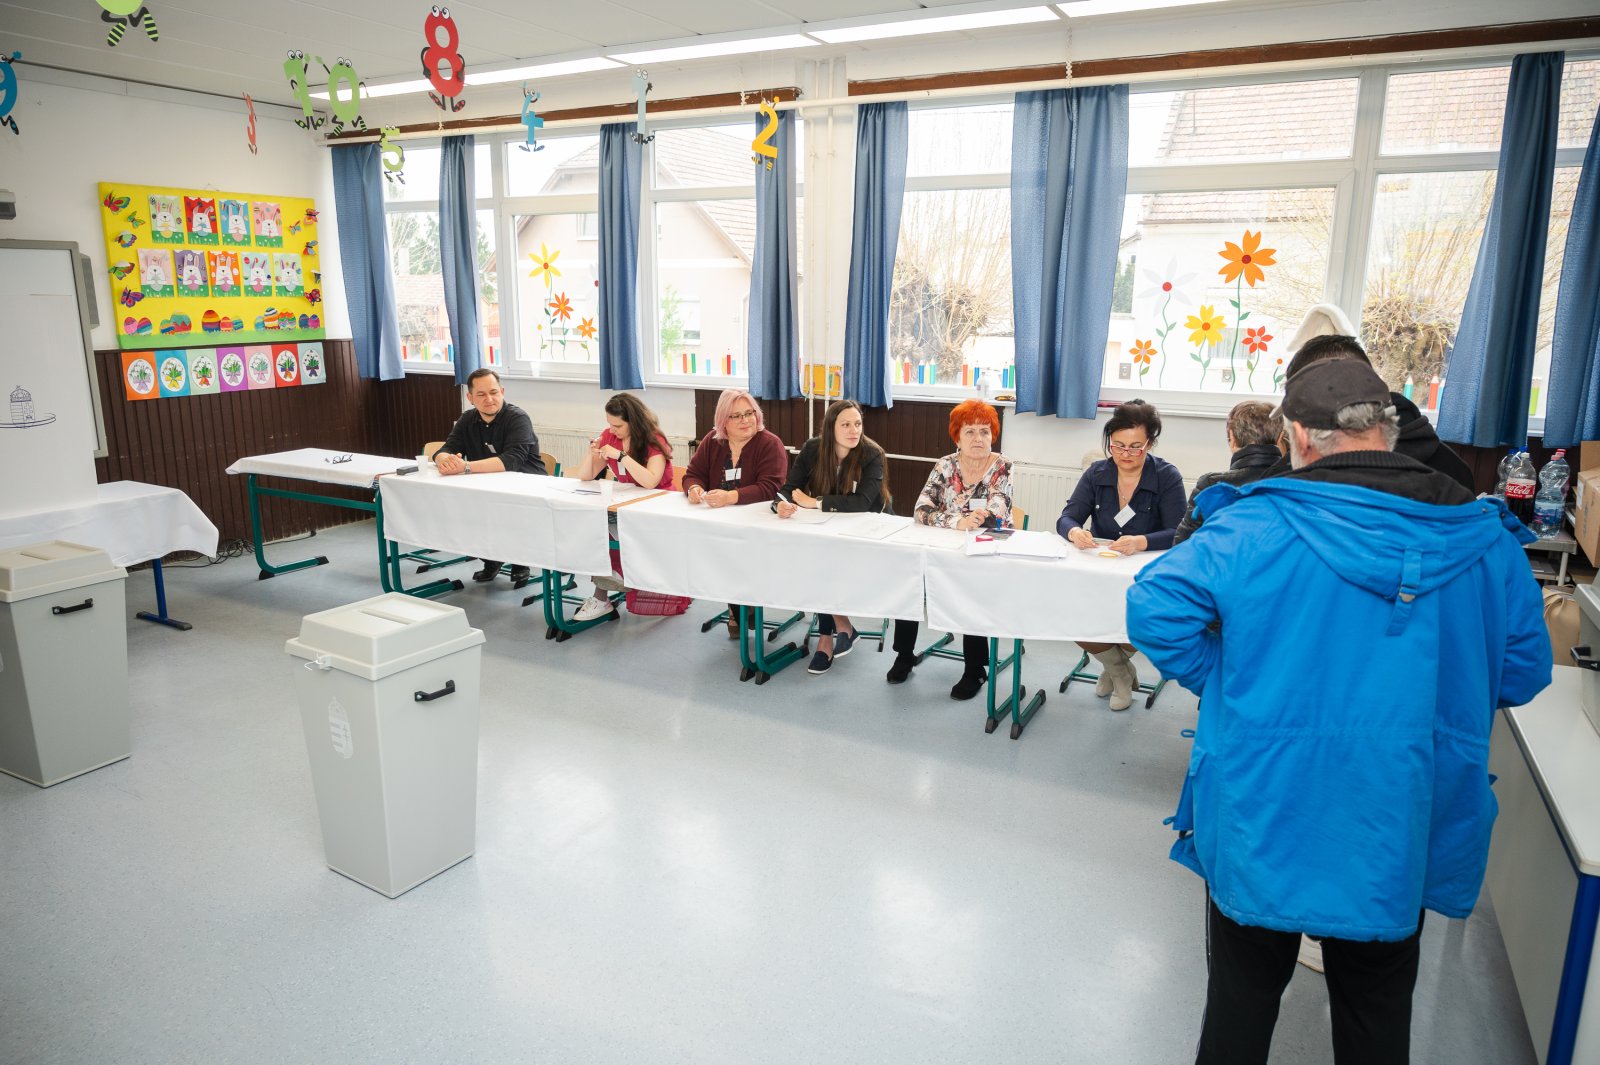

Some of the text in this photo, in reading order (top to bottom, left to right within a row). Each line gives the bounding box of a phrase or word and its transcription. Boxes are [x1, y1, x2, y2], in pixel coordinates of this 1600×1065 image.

[425, 9, 464, 97] 8
[283, 57, 361, 123] 10
[521, 92, 544, 144] 4
[381, 127, 405, 172] 5
[752, 101, 779, 158] 2
